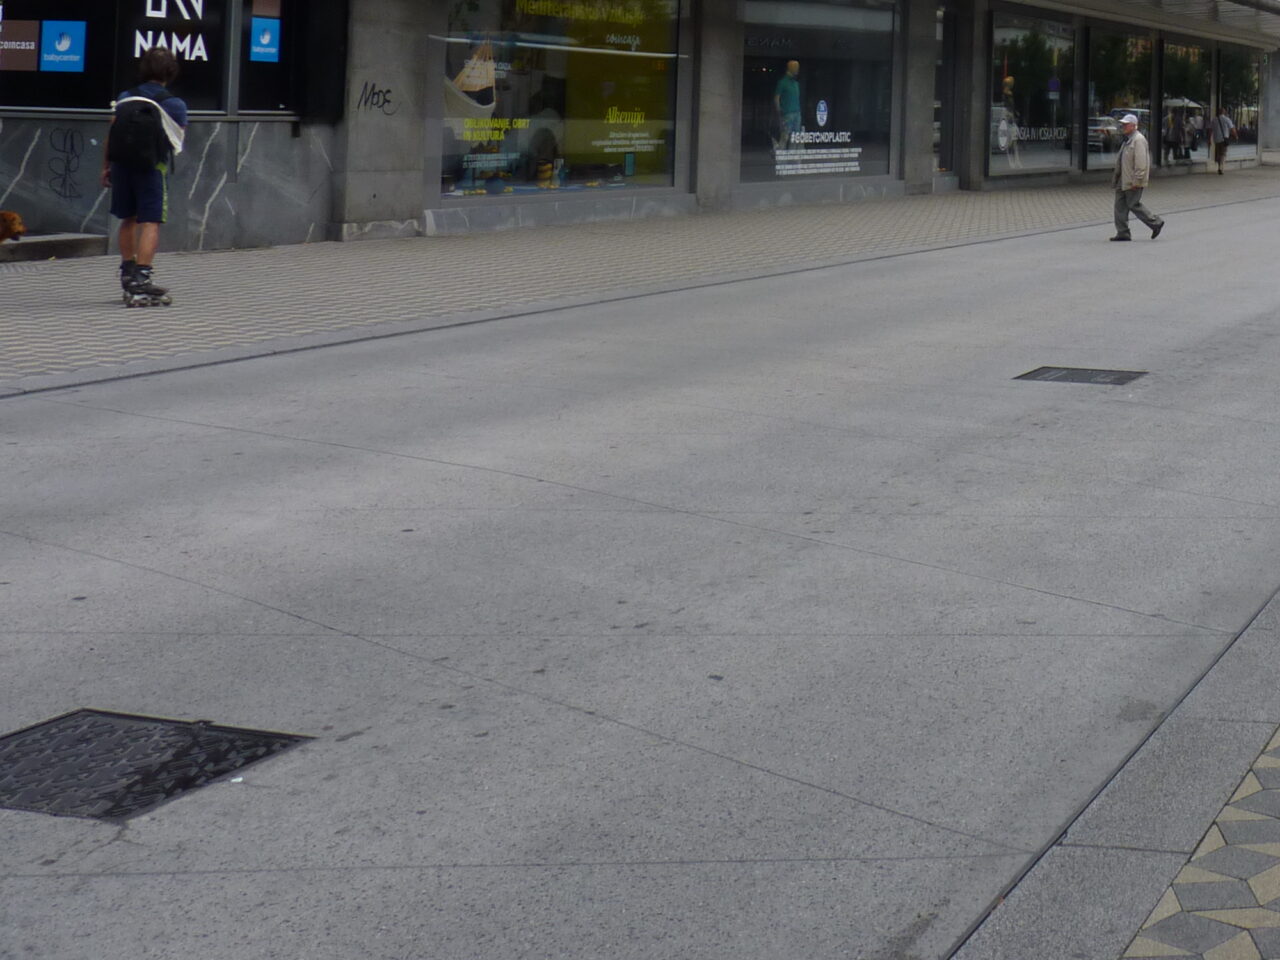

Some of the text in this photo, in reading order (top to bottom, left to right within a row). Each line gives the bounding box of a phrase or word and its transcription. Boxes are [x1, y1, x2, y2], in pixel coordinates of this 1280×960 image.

[134, 29, 208, 61] NAMA
[44, 53, 81, 62] babycenter
[791, 131, 851, 143] #GOBEYONDPLASTIC
